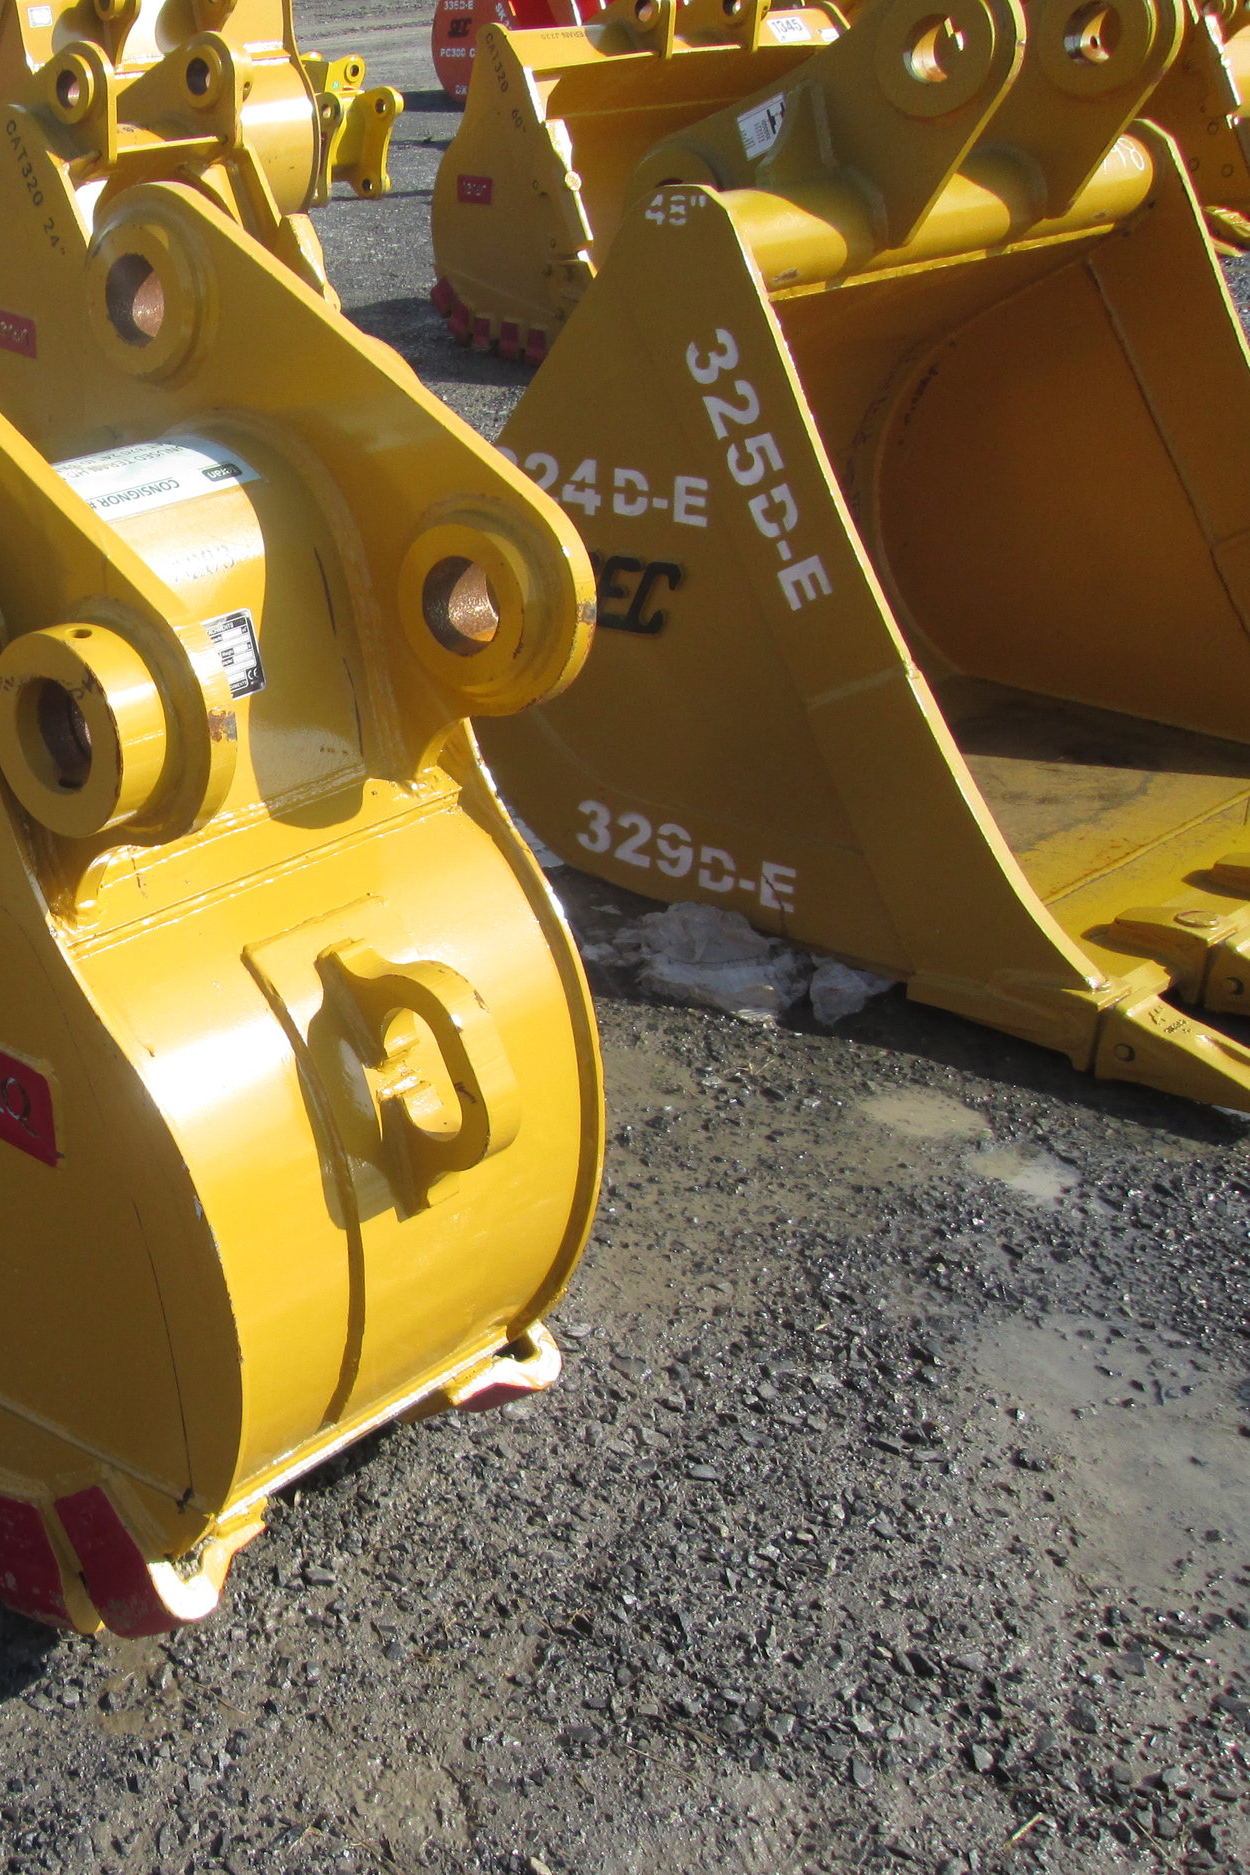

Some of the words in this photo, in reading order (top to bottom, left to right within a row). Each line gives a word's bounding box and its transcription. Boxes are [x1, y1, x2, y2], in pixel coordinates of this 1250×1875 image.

[440, 48, 465, 57] PC300
[771, 18, 803, 33] 1345
[485, 33, 509, 93] CAT320
[6, 119, 44, 207] CAT320
[102, 479, 180, 508] CONSIGNOR
[685, 328, 833, 611] 325D-E
[596, 551, 683, 634] EC
[576, 799, 797, 913] 329D-E
